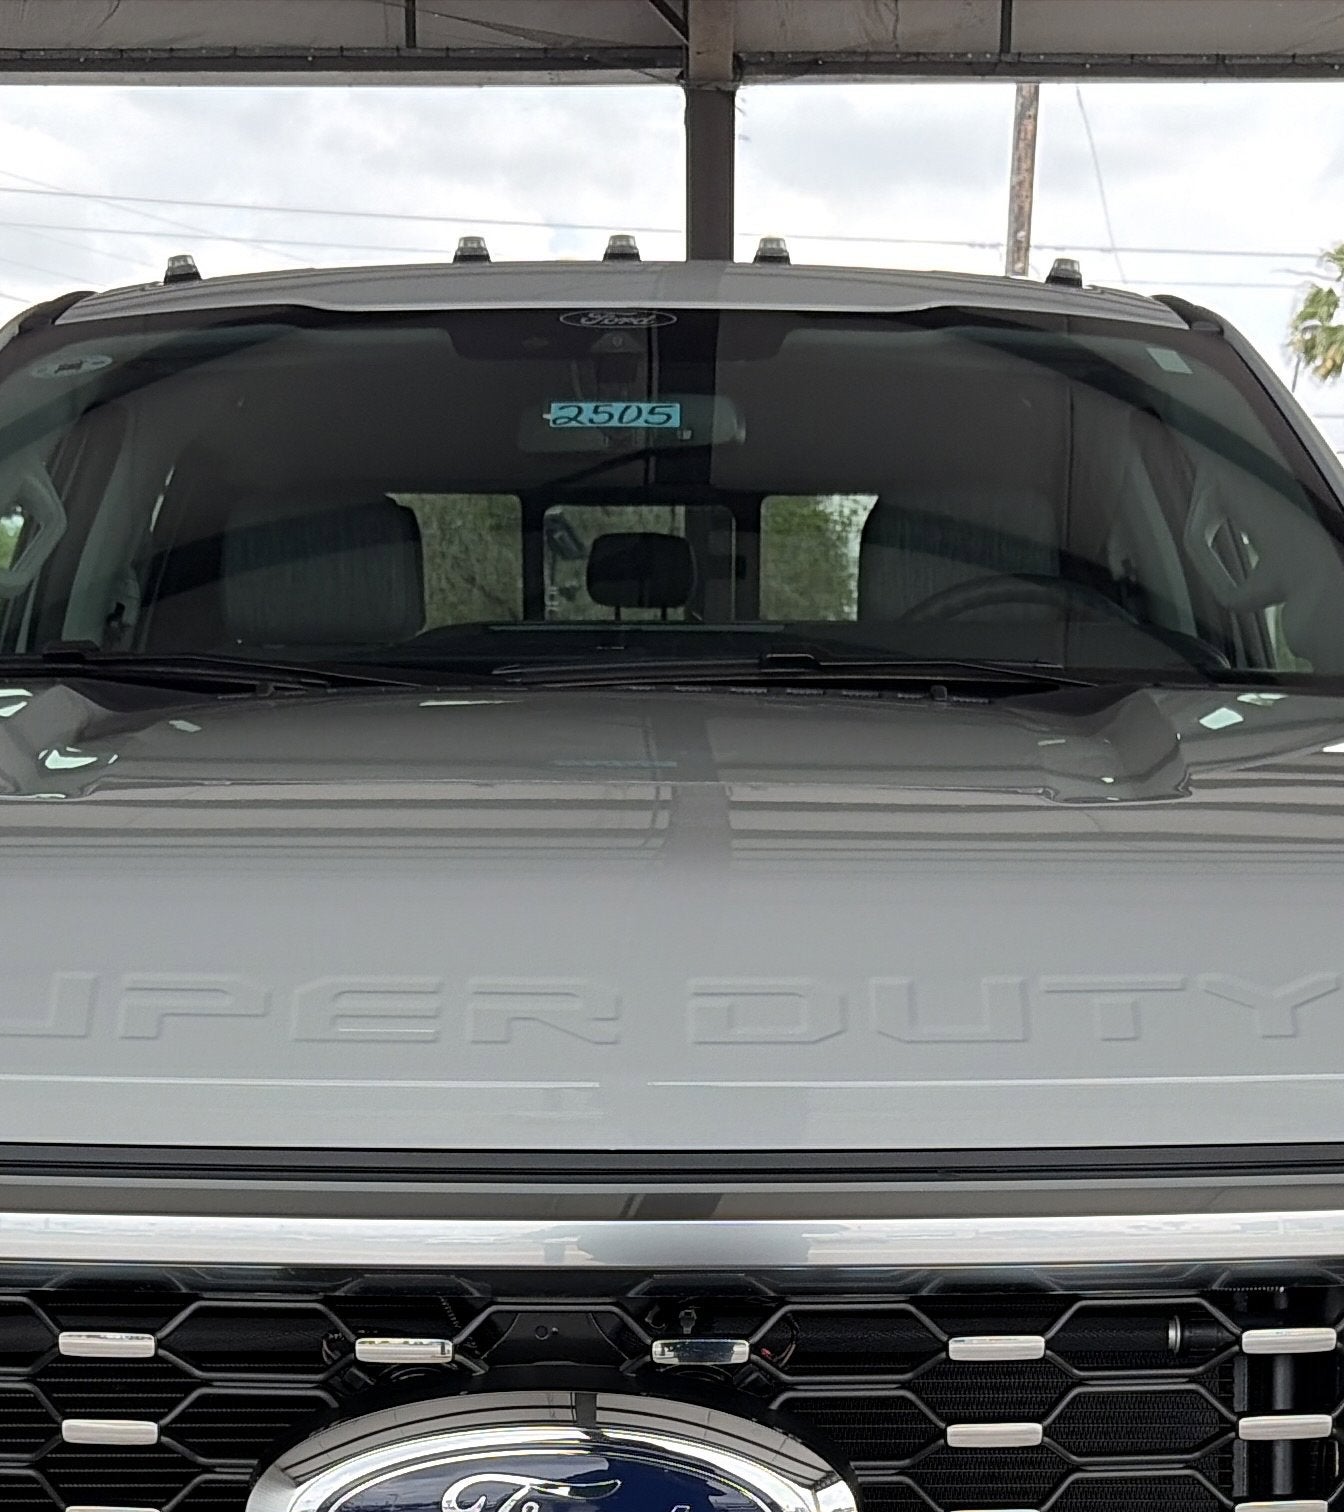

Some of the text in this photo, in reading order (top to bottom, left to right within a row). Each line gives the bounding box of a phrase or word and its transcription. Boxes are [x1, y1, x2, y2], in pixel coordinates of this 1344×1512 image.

[580, 310, 656, 326] Ford
[552, 404, 674, 427] 2505
[686, 972, 1343, 1045] DUTY
